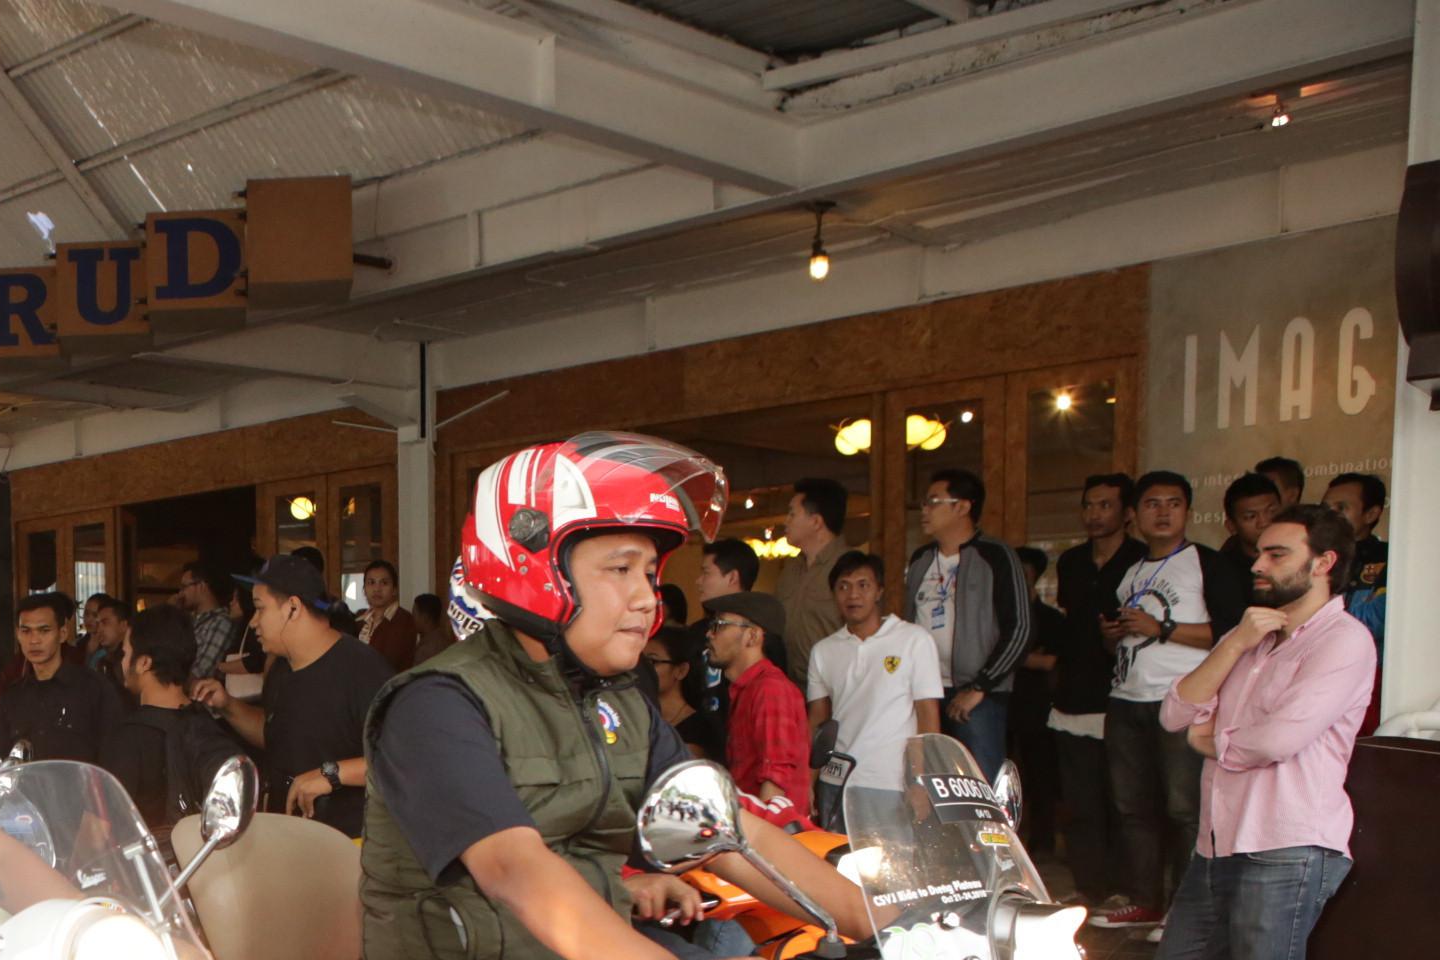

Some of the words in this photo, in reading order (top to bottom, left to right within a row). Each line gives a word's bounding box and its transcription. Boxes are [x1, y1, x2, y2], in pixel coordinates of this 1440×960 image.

[931, 778, 950, 798] B
[948, 777, 982, 799] 6006
[917, 888, 929, 898] to
